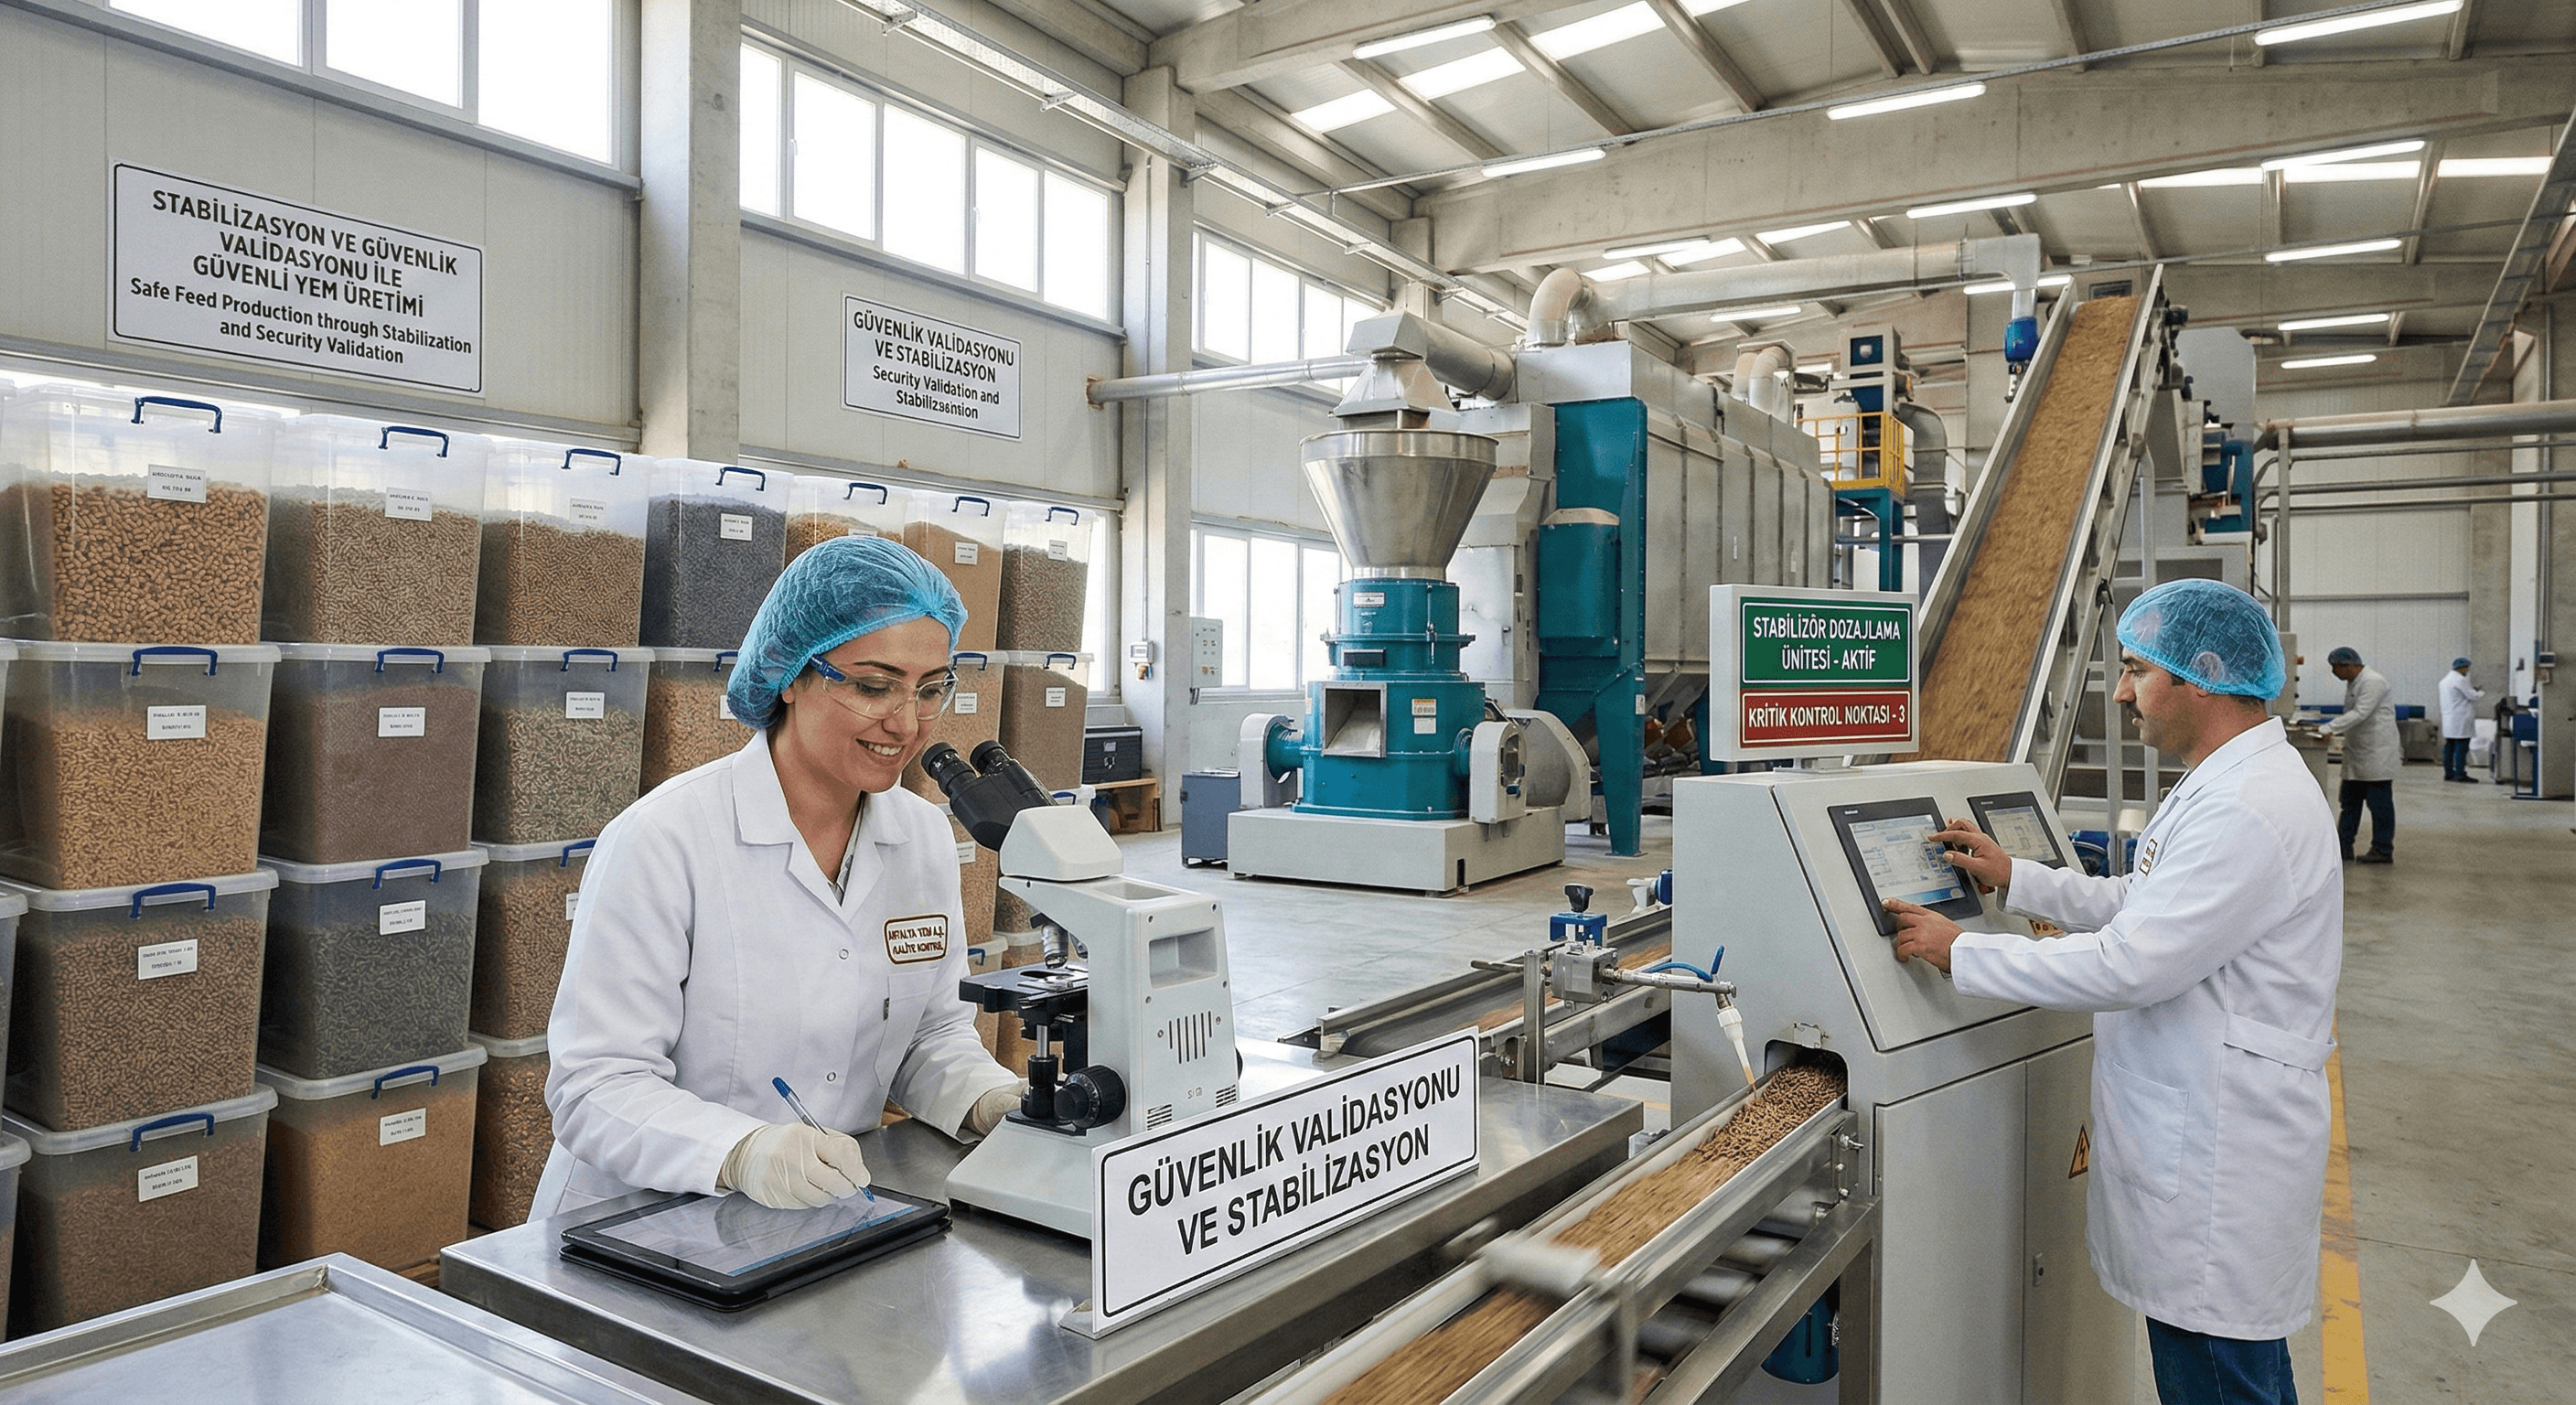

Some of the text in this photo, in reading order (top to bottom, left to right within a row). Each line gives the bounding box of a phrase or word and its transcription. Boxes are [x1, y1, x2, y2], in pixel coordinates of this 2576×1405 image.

[153, 189, 457, 275] STABİLİZASYON VE GÜVENLİK
[220, 231, 402, 288] VALİDASYONU İLE
[193, 253, 424, 317] GÜVENLİ YEM ÜRETİMİ
[131, 278, 471, 353] Safe Feed Production through Stabilization
[220, 319, 403, 363] and Security Validation
[853, 310, 1014, 366] GÜVENLİK VALİDASYONU
[873, 365, 999, 404] Security Validation and
[875, 339, 995, 383] VE STABİLİZASYON
[1830, 618, 1901, 639] DOZAJLAMA
[1782, 645, 1830, 670] ÜNİTESİ
[1841, 645, 1876, 670] AKTİF
[1749, 702, 1787, 727] KRİTİK
[1790, 705, 1841, 725] KONTROL
[1845, 705, 1890, 724] NOKTASI
[1899, 705, 1905, 723] 3
[1128, 1064, 1461, 1216] GÜVENLİK VALİDASYONU
[1178, 1124, 1430, 1255] VE STABİLİZASYON
